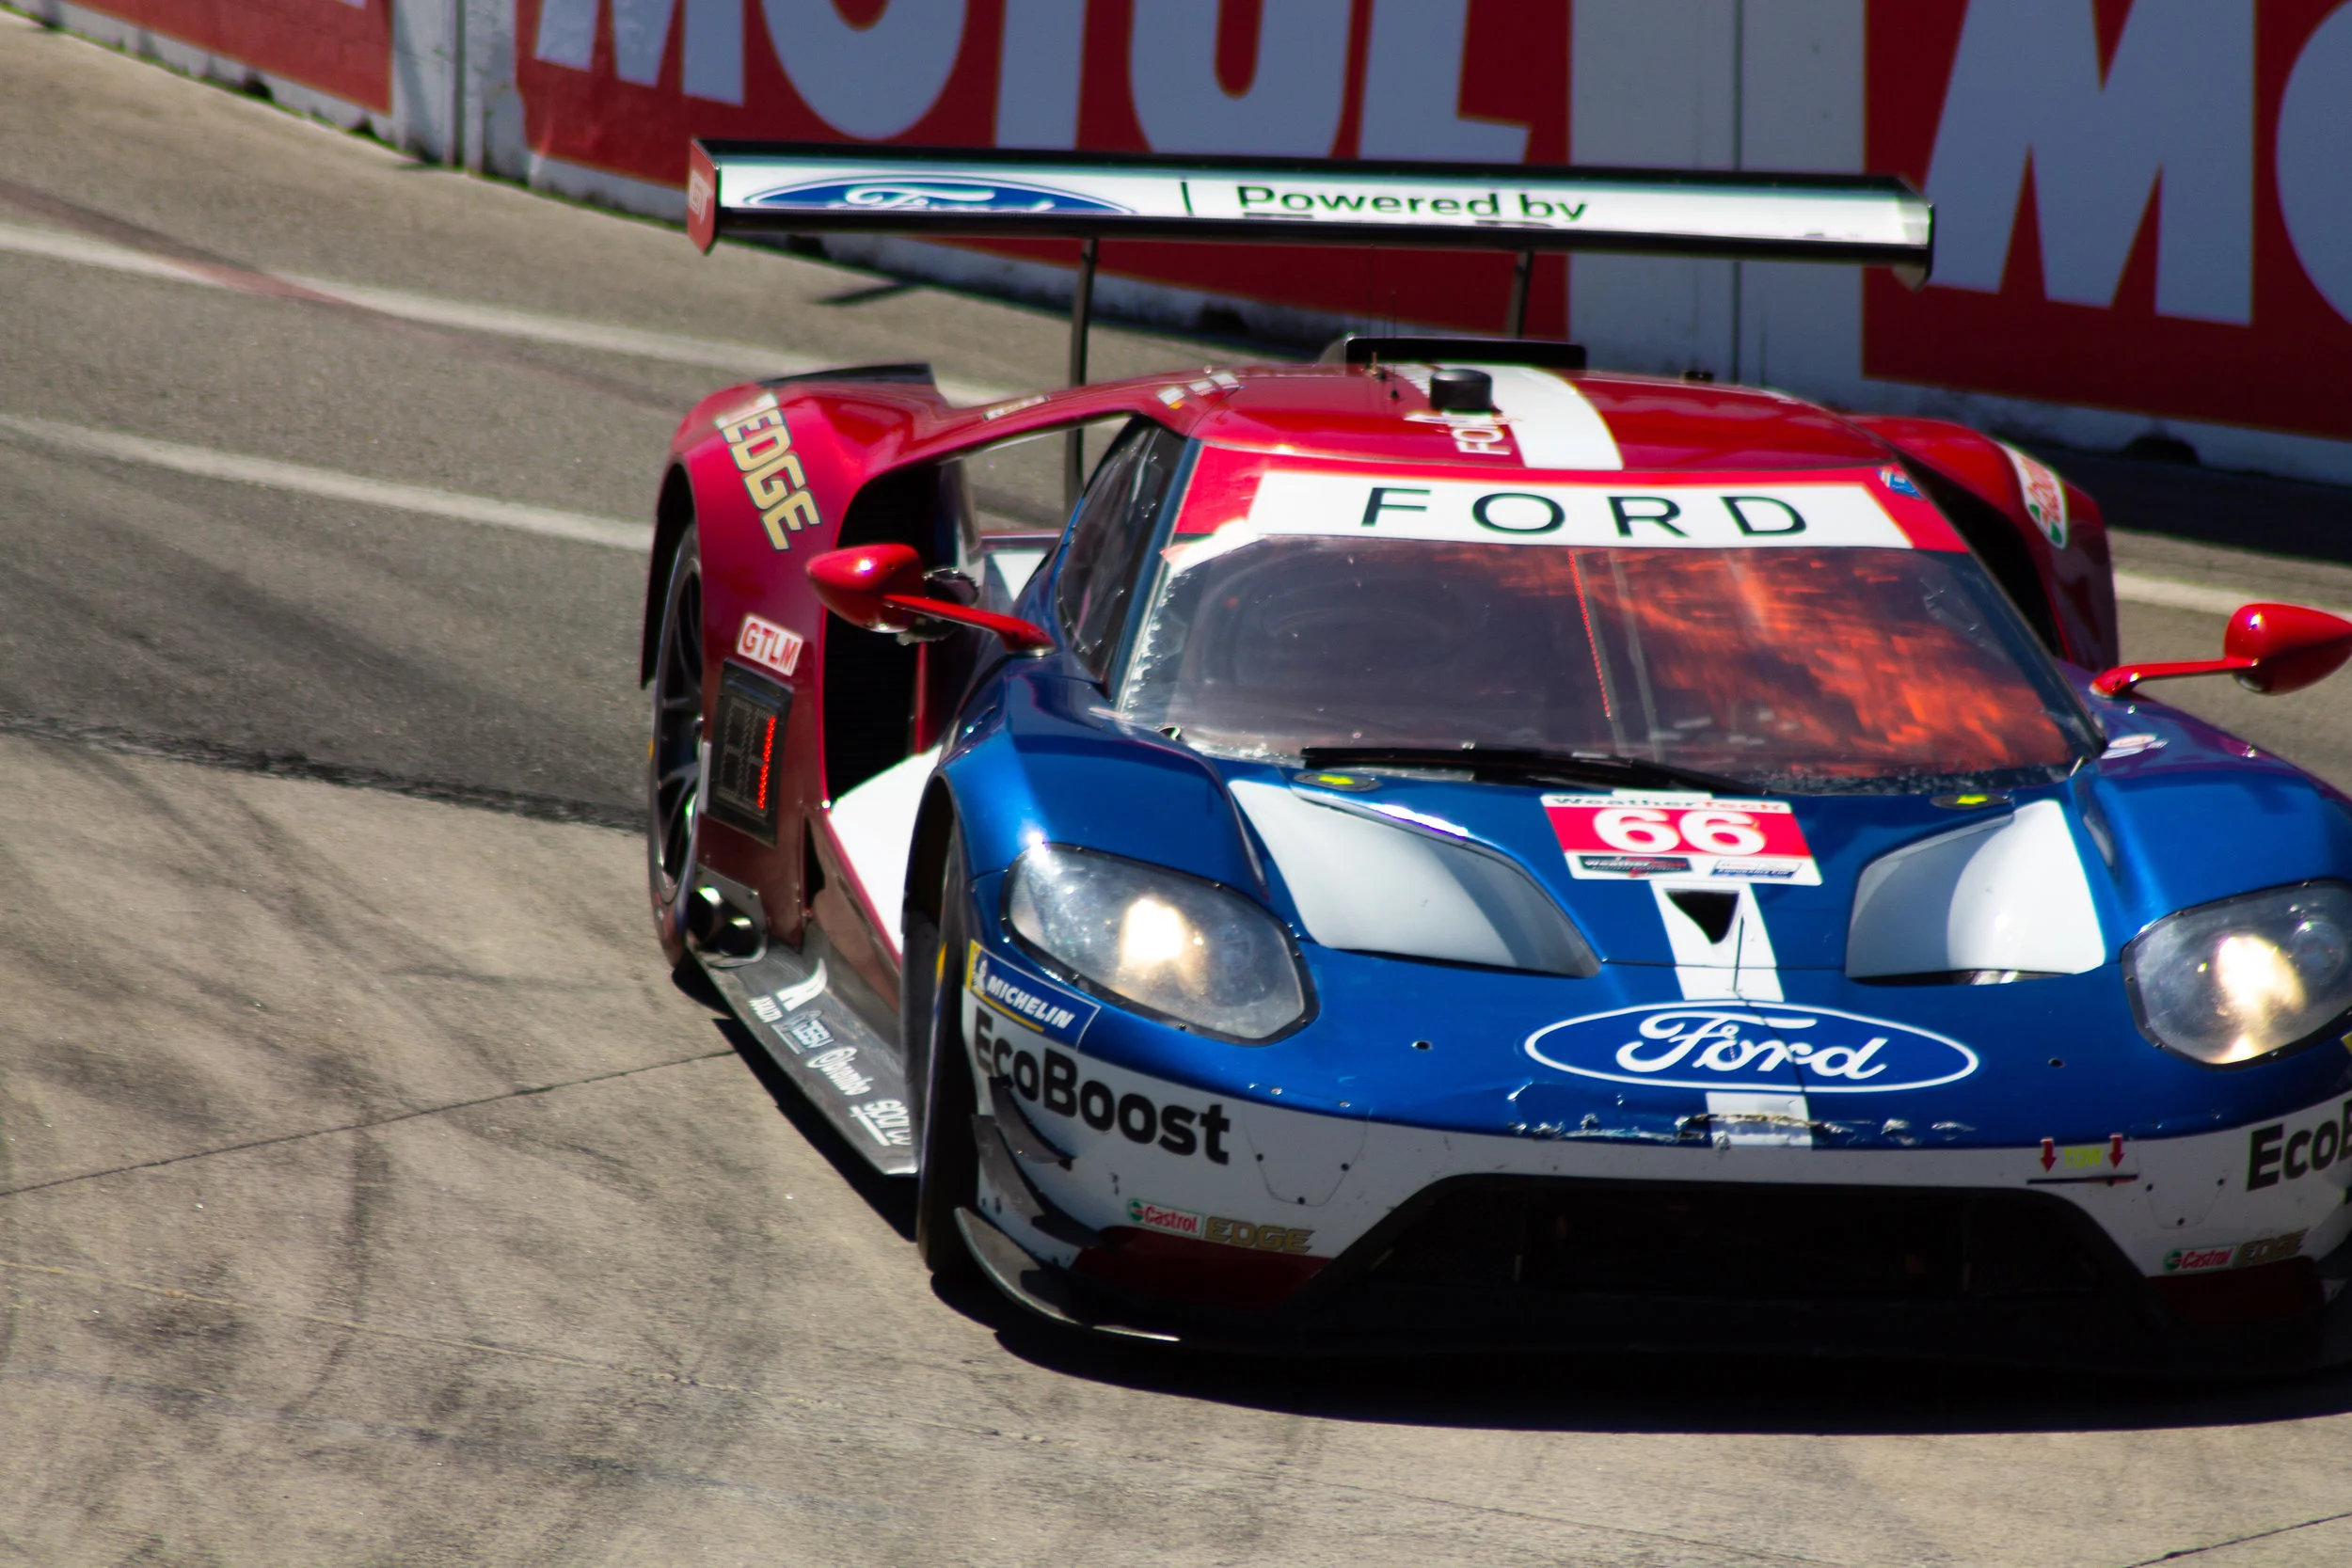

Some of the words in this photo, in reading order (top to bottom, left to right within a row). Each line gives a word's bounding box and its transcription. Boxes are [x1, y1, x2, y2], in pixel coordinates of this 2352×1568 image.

[1236, 185, 1501, 217] Powered
[1519, 194, 1587, 221] by
[721, 407, 822, 551] EDGE
[1360, 486, 1807, 538] FORD
[742, 622, 799, 672] GTLM
[1593, 808, 1767, 856] 66
[988, 974, 1075, 1030] MICHELIN
[1615, 1011, 1888, 1080] Ford
[975, 1005, 1232, 1166] EcoBoost
[2063, 1147, 2104, 1168] TOW
[1144, 1205, 1198, 1233] Castrol
[1205, 1216, 1315, 1254] EDGE
[2181, 1247, 2233, 1270] Castrol
[2234, 1227, 2308, 1265] EDGE
